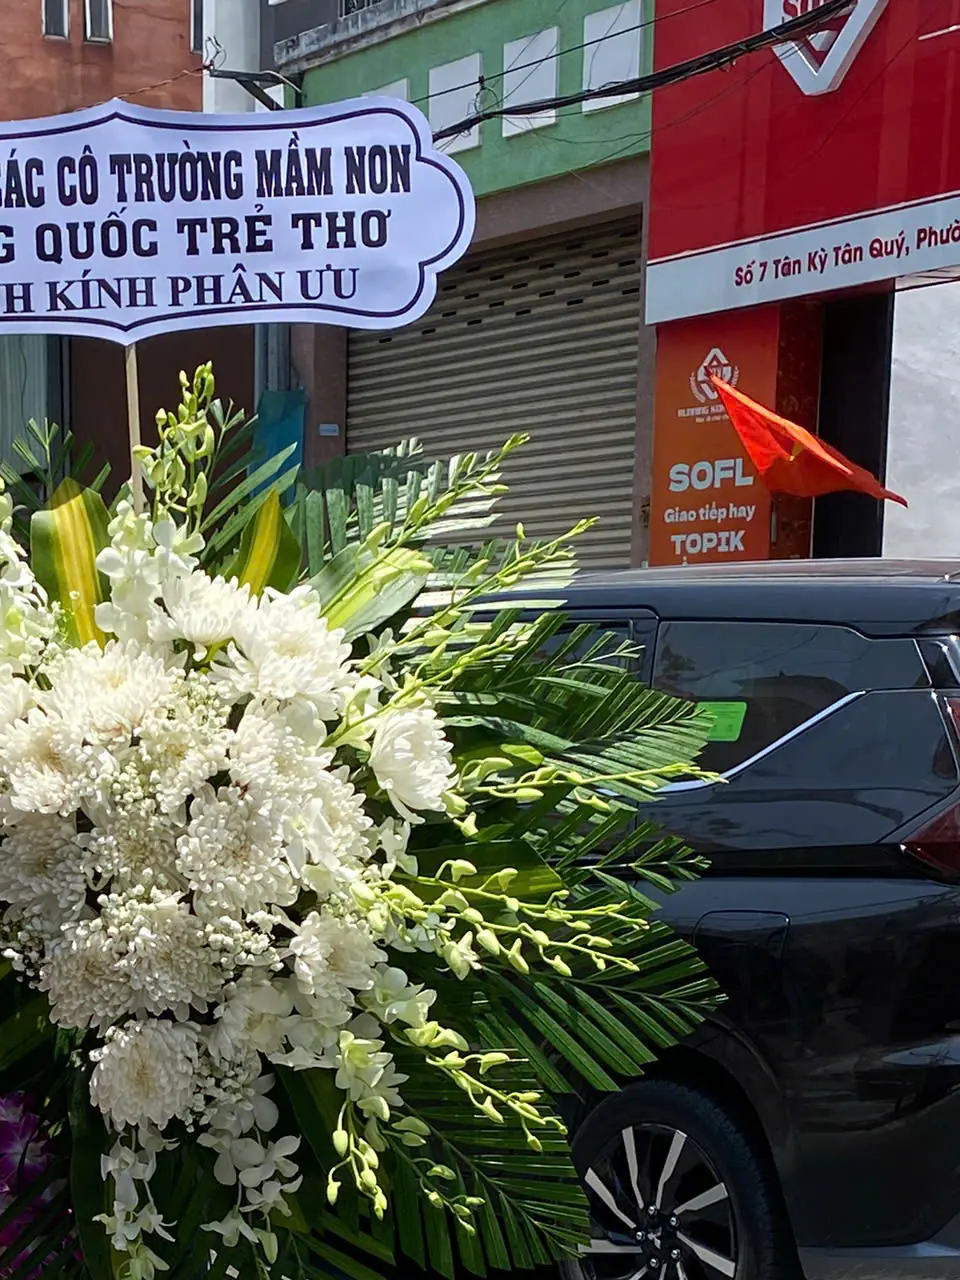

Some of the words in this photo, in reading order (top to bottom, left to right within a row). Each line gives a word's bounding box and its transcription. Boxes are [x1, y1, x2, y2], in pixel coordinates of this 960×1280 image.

[57, 144, 99, 206] CÔ
[109, 139, 244, 203] TRƯỜNG
[254, 131, 334, 198] MẦM
[344, 144, 412, 195] NON
[35, 207, 159, 265] QUỐC
[176, 203, 273, 256] TRẺ
[291, 209, 392, 250] THƠ
[734, 260, 756, 287] Số
[758, 261, 768, 283] 7
[772, 256, 802, 279] Tân
[807, 248, 828, 274] Kỳ
[832, 243, 864, 267] Tân
[44, 269, 158, 313] KÍNH
[166, 263, 285, 307] PHÂN
[296, 263, 360, 300] ƯU
[668, 458, 754, 493] SOFL
[664, 507, 697, 524] Giao
[699, 501, 727, 524] tiếp
[729, 503, 756, 522] hay
[670, 530, 746, 555] TOPIK
